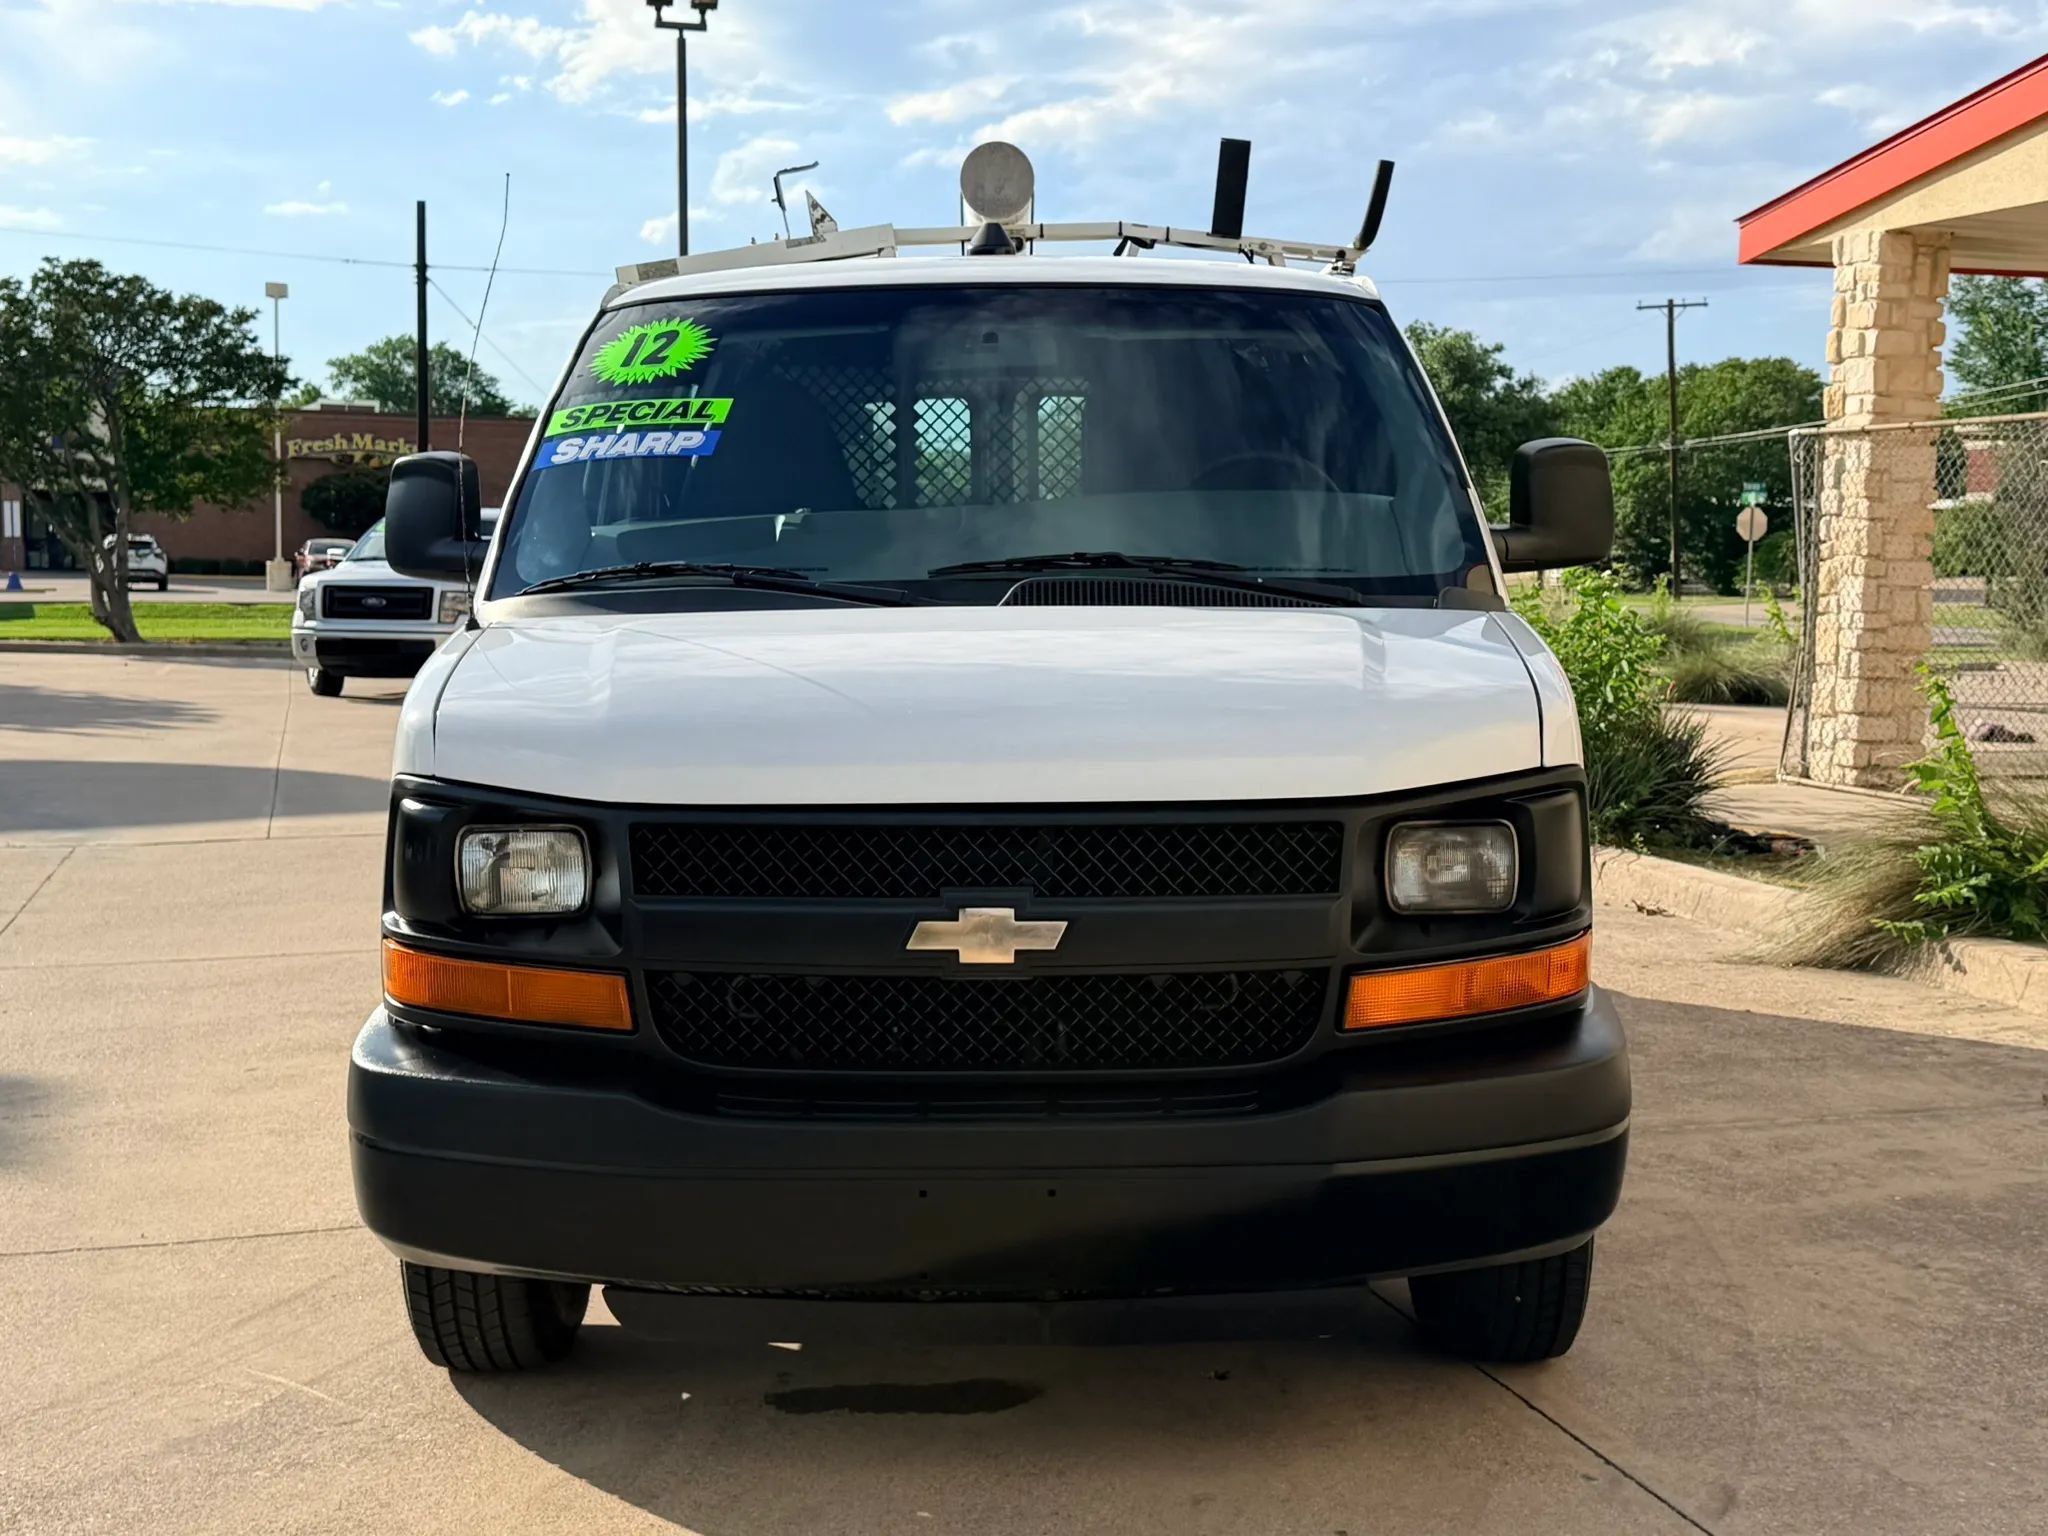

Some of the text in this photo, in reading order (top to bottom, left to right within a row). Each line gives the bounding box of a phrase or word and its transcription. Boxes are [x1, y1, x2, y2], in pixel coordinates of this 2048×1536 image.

[620, 329, 681, 367] 12
[560, 400, 715, 429] SPECIAL
[287, 433, 431, 458] Fresh Mark
[551, 431, 705, 464] SHARP
